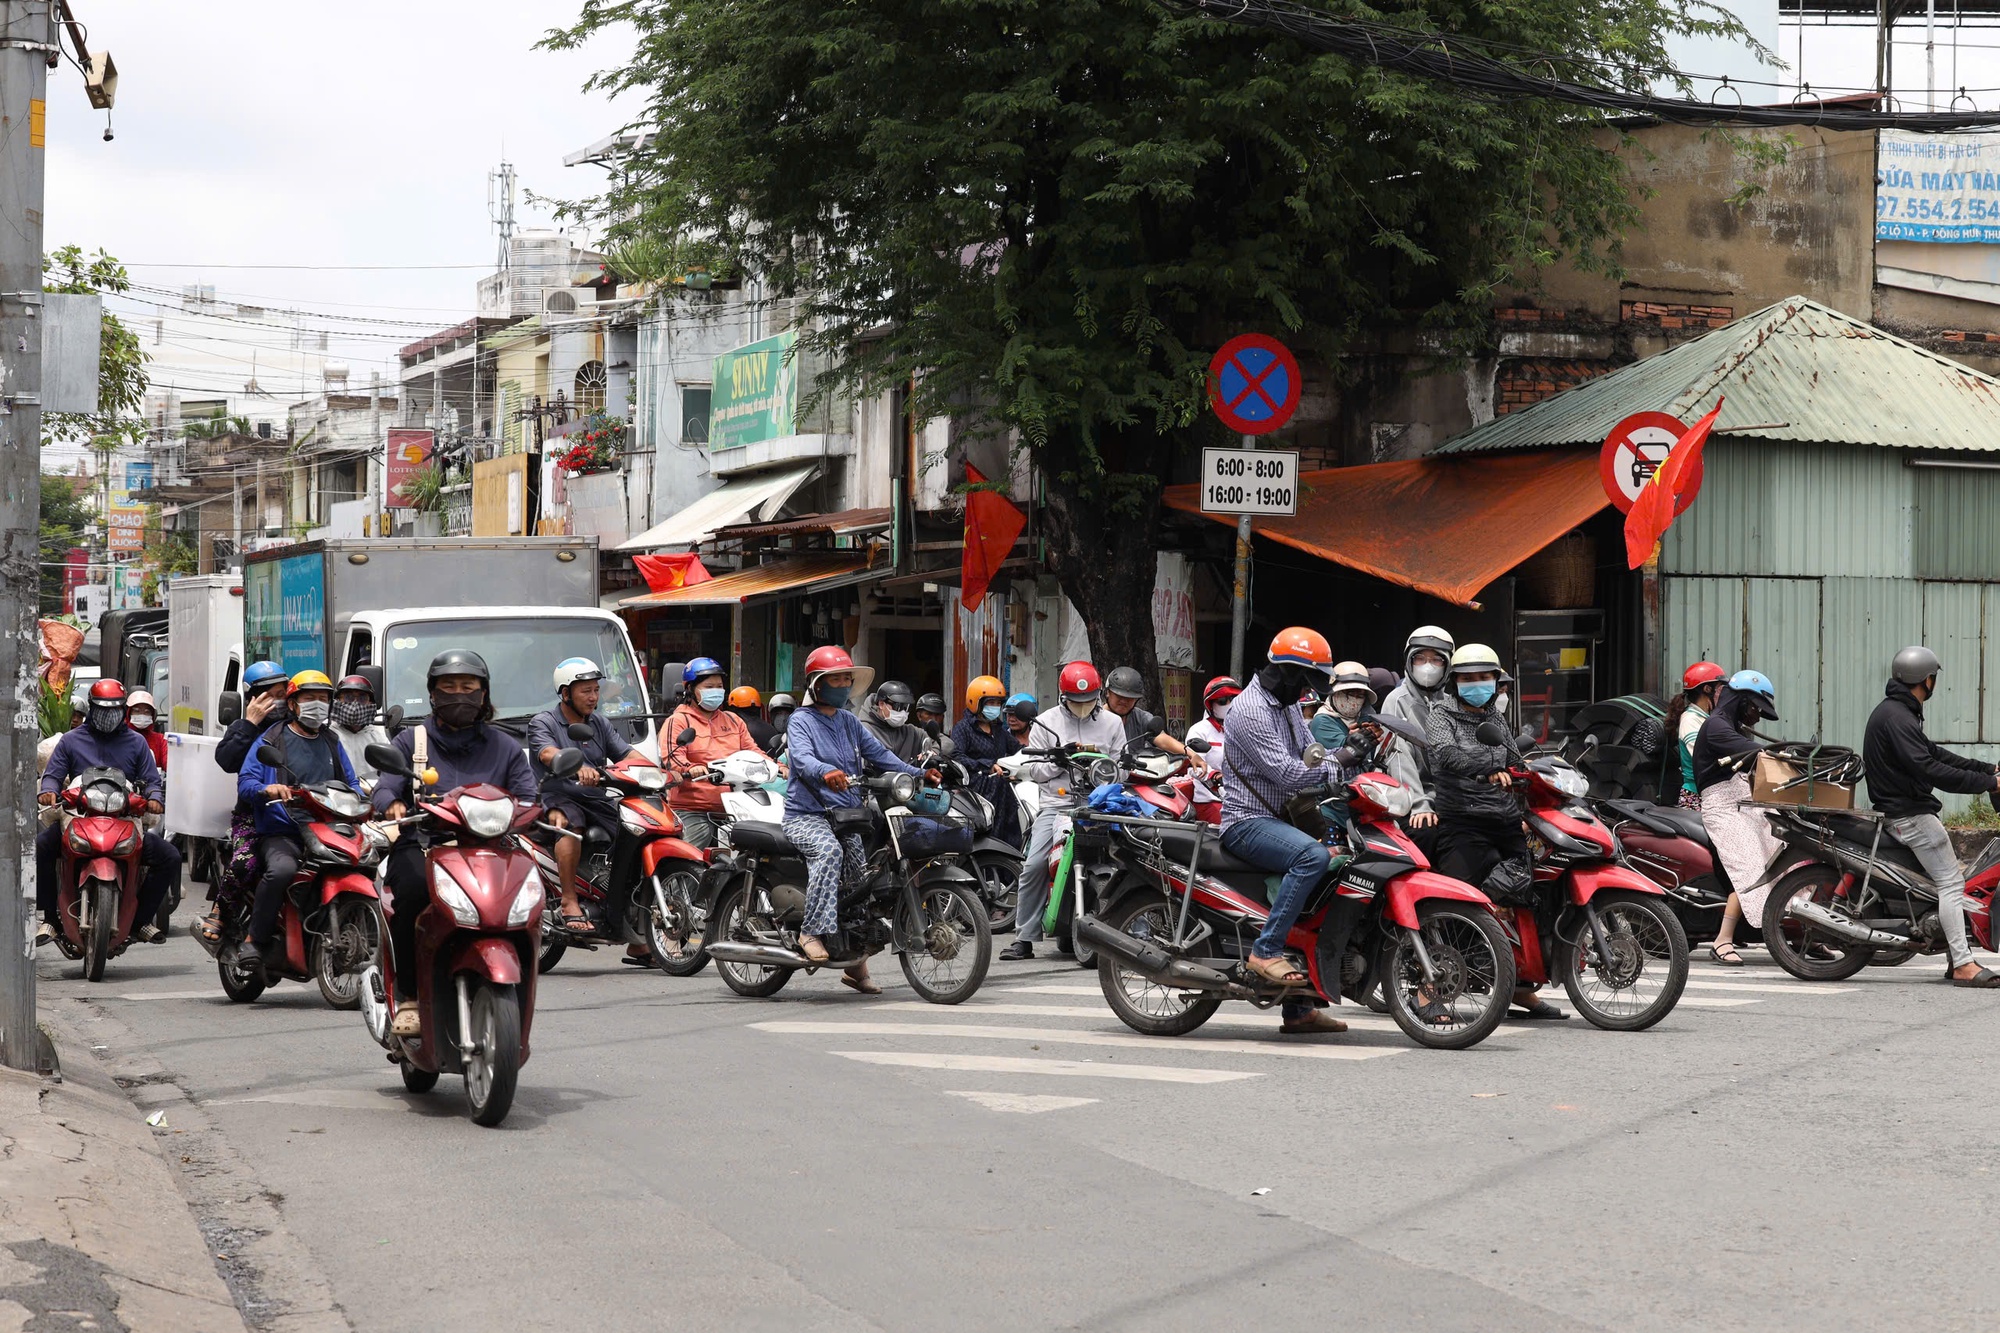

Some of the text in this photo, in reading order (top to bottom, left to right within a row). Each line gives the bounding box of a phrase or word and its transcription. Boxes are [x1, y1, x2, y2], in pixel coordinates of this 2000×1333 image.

[1888, 142, 1912, 157] TNHH
[1922, 169, 1966, 190] MÁY
[731, 349, 769, 400] SUNNY
[1217, 458, 1245, 476] 6:00
[1256, 460, 1284, 478] 8:00
[1209, 485, 1243, 504] 16:00
[1256, 487, 1291, 506] 19:00
[111, 512, 142, 527] CHÁO
[1348, 874, 1376, 890] YAMAHA
